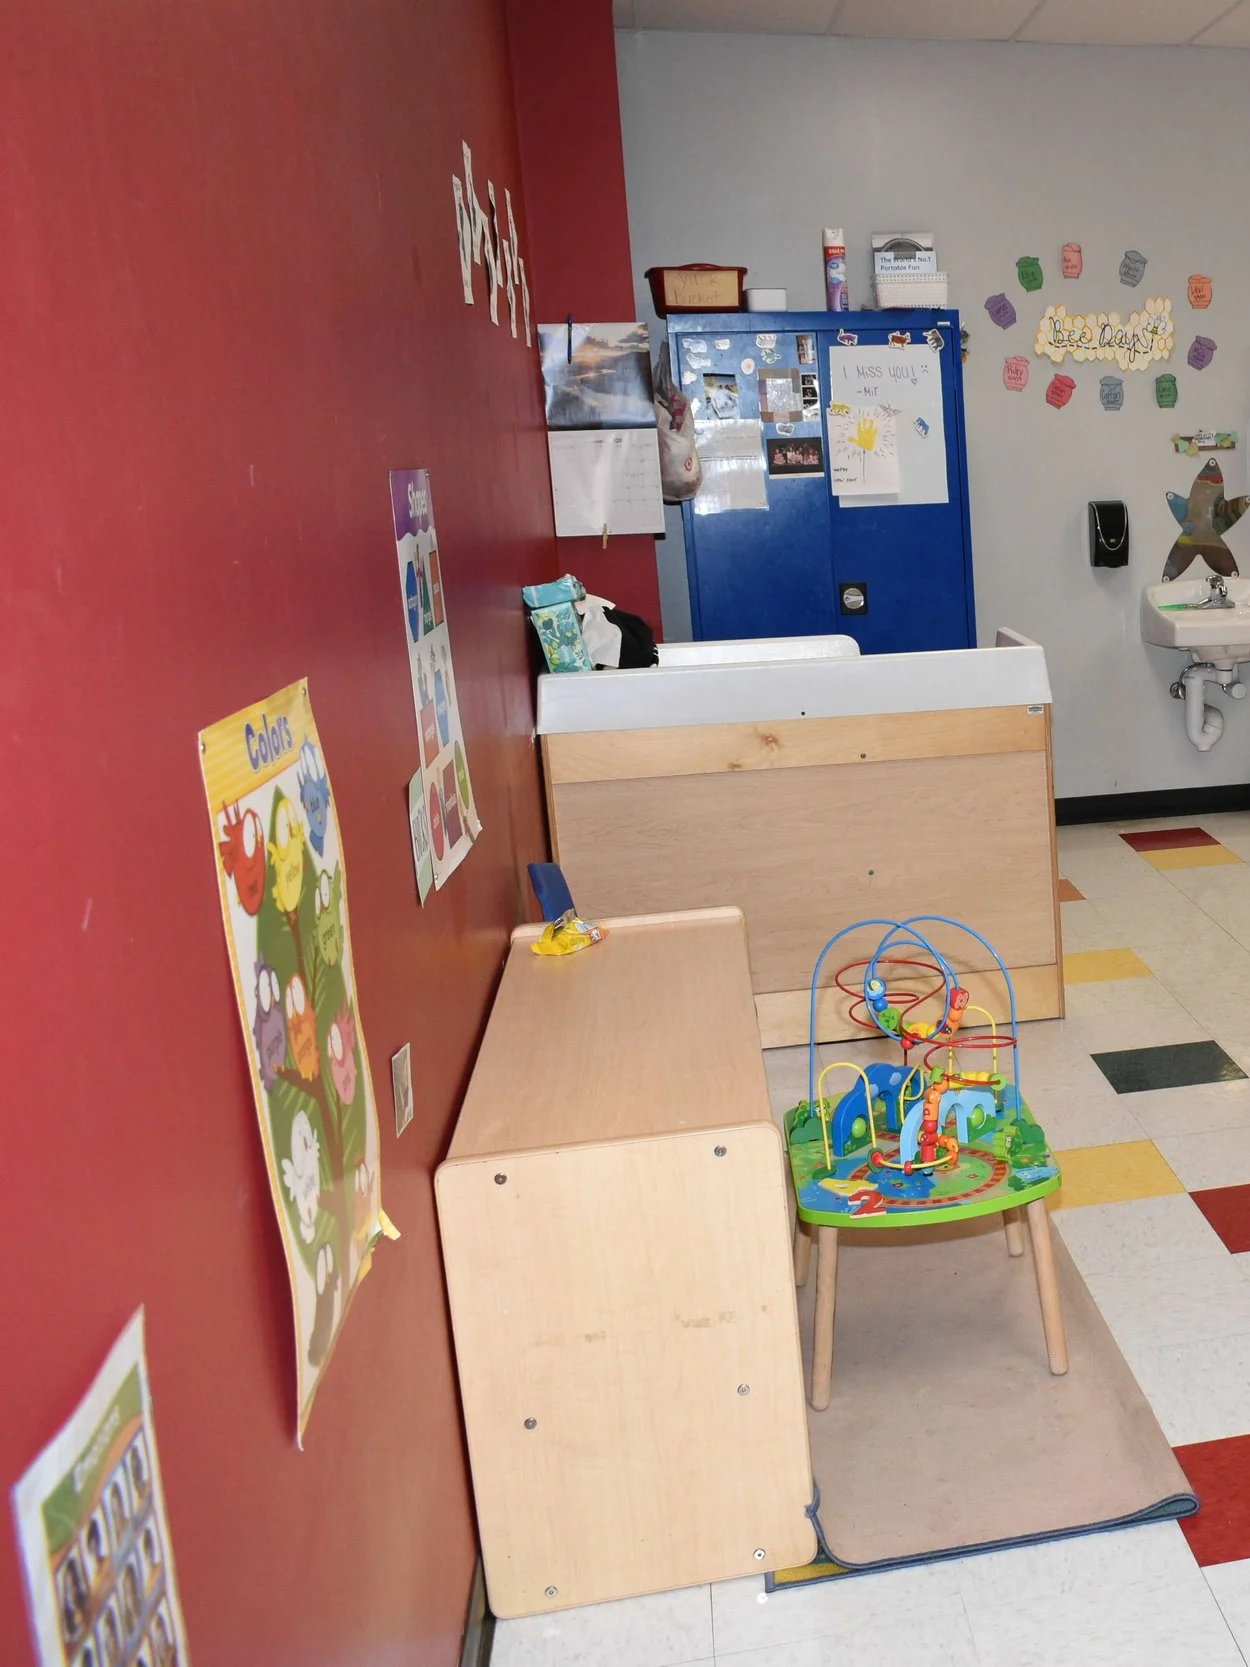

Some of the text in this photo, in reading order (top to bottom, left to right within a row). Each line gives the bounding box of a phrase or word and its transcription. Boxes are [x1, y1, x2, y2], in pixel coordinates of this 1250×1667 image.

[1049, 316, 1093, 345] Bee
[842, 366, 847, 379] I
[408, 481, 428, 525] Shapes
[244, 714, 294, 774] Colors
[322, 922, 335, 945] green
